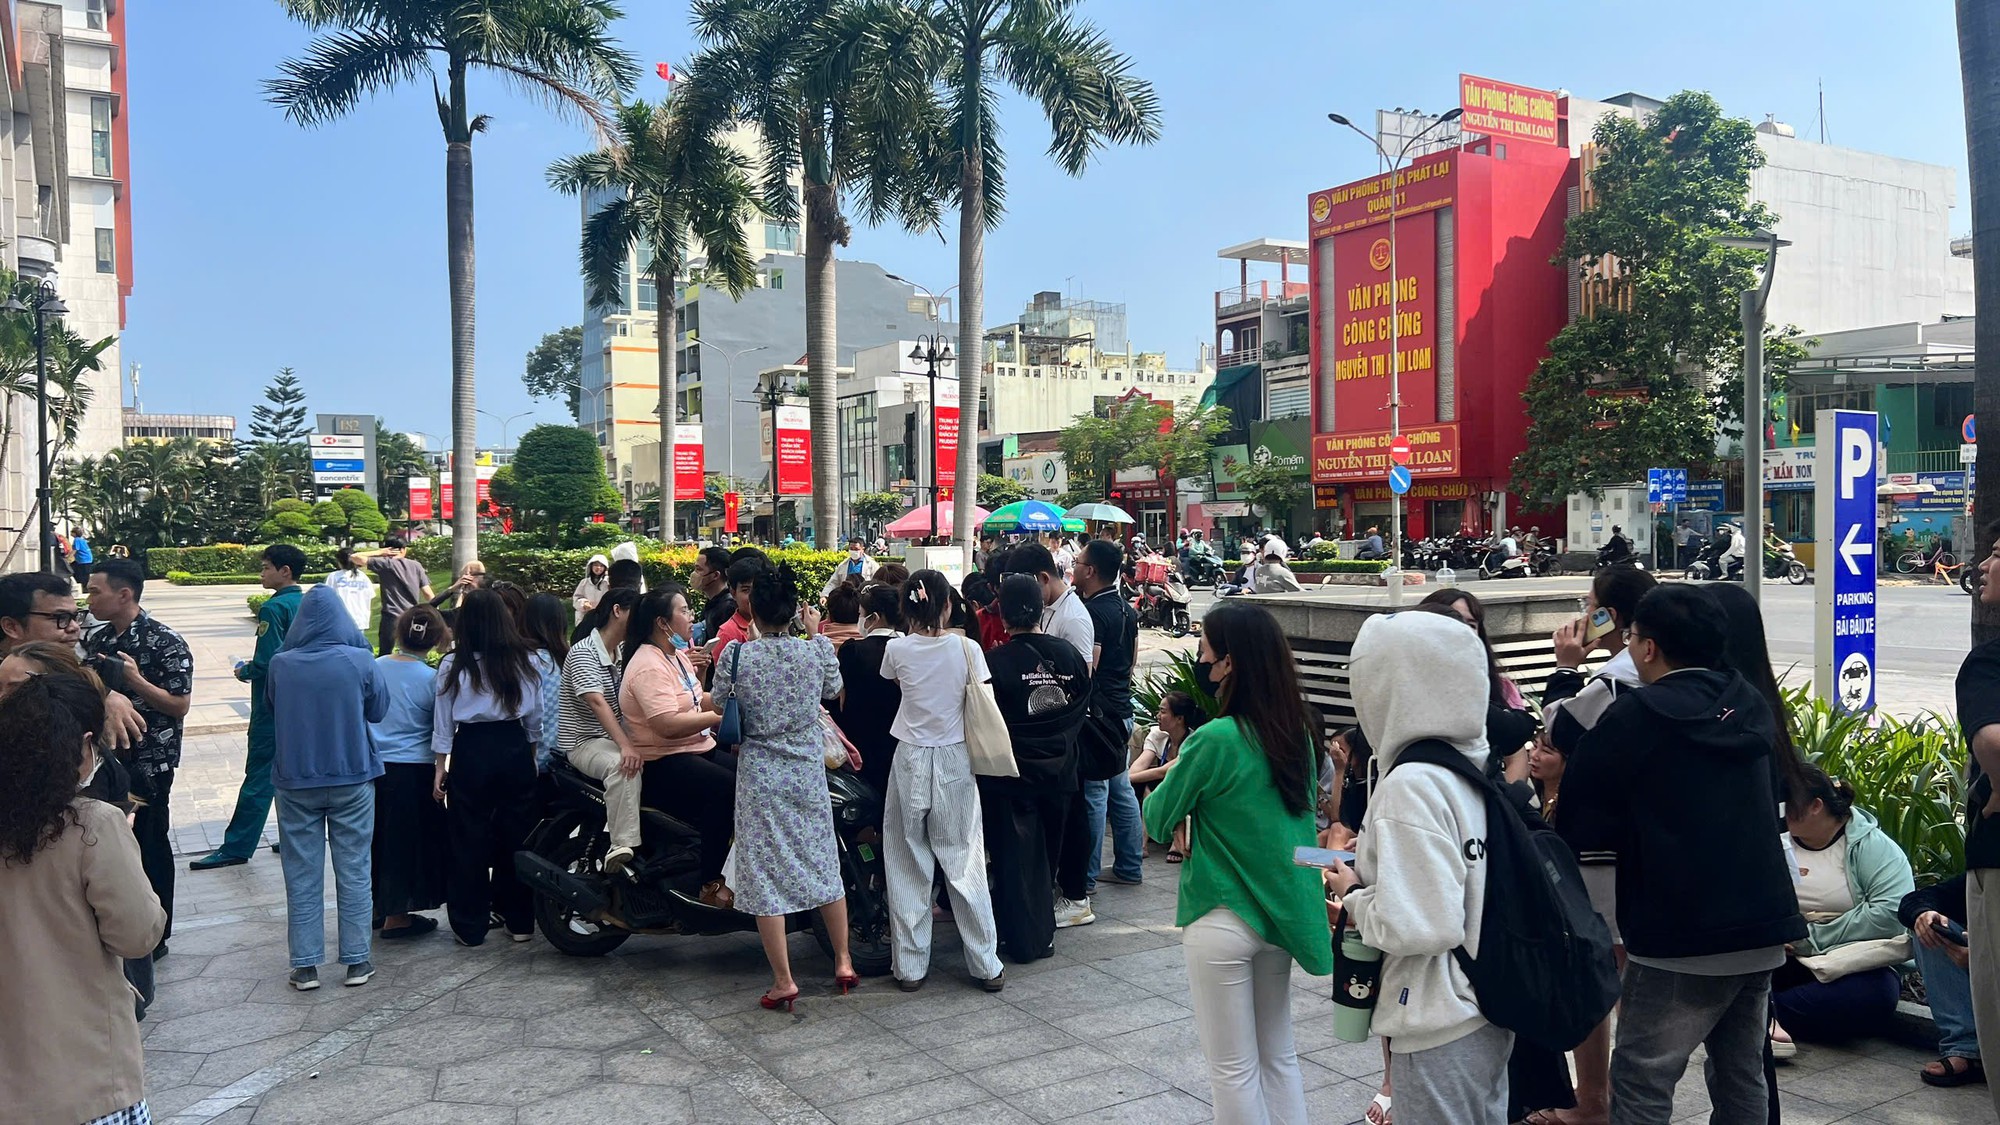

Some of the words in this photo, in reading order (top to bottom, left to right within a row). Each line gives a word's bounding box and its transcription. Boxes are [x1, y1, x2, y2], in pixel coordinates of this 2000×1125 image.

[1500, 118, 1514, 134] THỊ
[1515, 120, 1531, 135] KIM
[1532, 124, 1554, 138] LOAN
[1331, 188, 1351, 205] VĂN
[1350, 181, 1380, 201] PHÒNG
[1408, 164, 1431, 184] PHÁT
[1434, 160, 1449, 178] LẠI
[1367, 194, 1392, 213] QUẬN
[1396, 192, 1406, 206] 11
[1348, 283, 1371, 312] VĂN
[1343, 317, 1375, 346] CÔNG
[1336, 351, 1368, 381] NGUYỄN
[1371, 354, 1385, 379] THỊ
[1407, 347, 1431, 371] LOAN
[1326, 438, 1343, 451] VĂN
[1346, 435, 1376, 450] PHÒNG
[1378, 434, 1392, 447] CÔ
[1317, 451, 1363, 470] NGUYỄN
[1365, 455, 1386, 470] THỊ
[1416, 449, 1452, 465] LOAN
[1841, 428, 1872, 499] P
[1796, 465, 1812, 478] NON
[1836, 591, 1874, 606] PARKING
[1836, 615, 1849, 636] BÃI
[1865, 617, 1874, 634] XE
